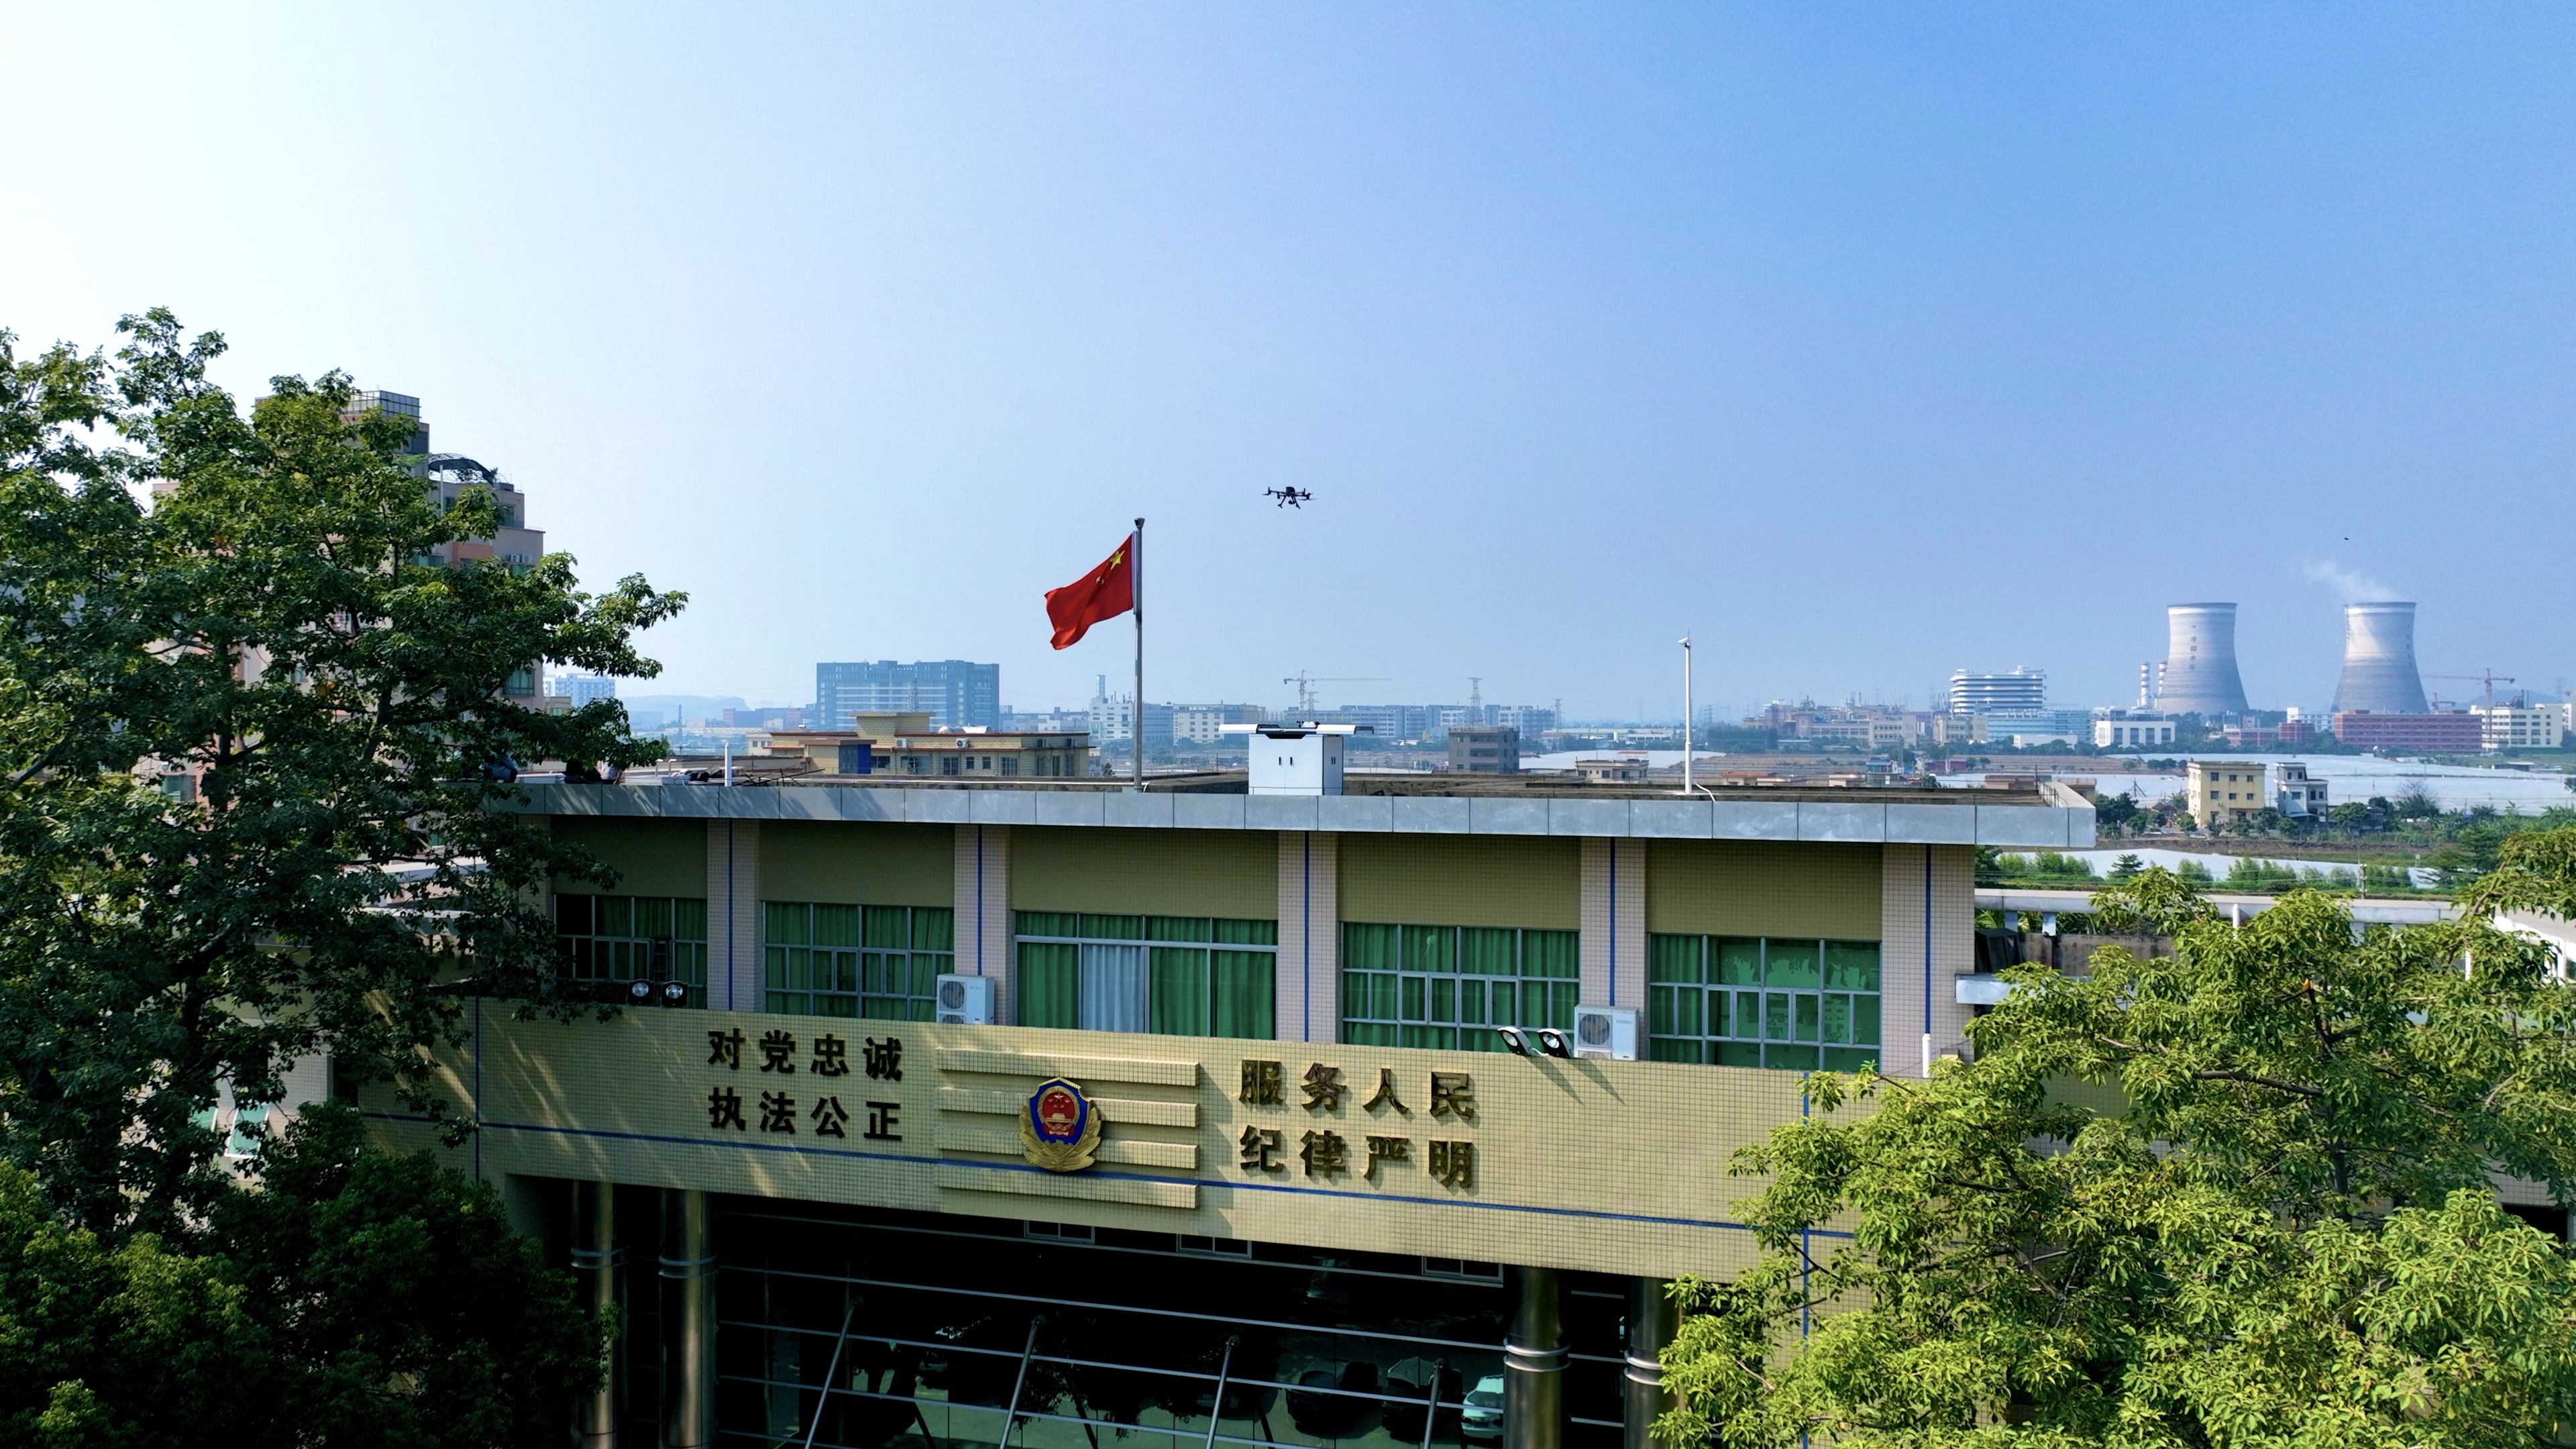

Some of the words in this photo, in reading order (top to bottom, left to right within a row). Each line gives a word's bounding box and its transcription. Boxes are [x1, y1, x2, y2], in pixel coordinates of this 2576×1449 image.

[708, 1028, 902, 1081] 对党忠诚
[708, 1087, 902, 1141] 执法公正
[1240, 1060, 1474, 1120] 服务人民
[1240, 1125, 1473, 1188] 纪律严明
